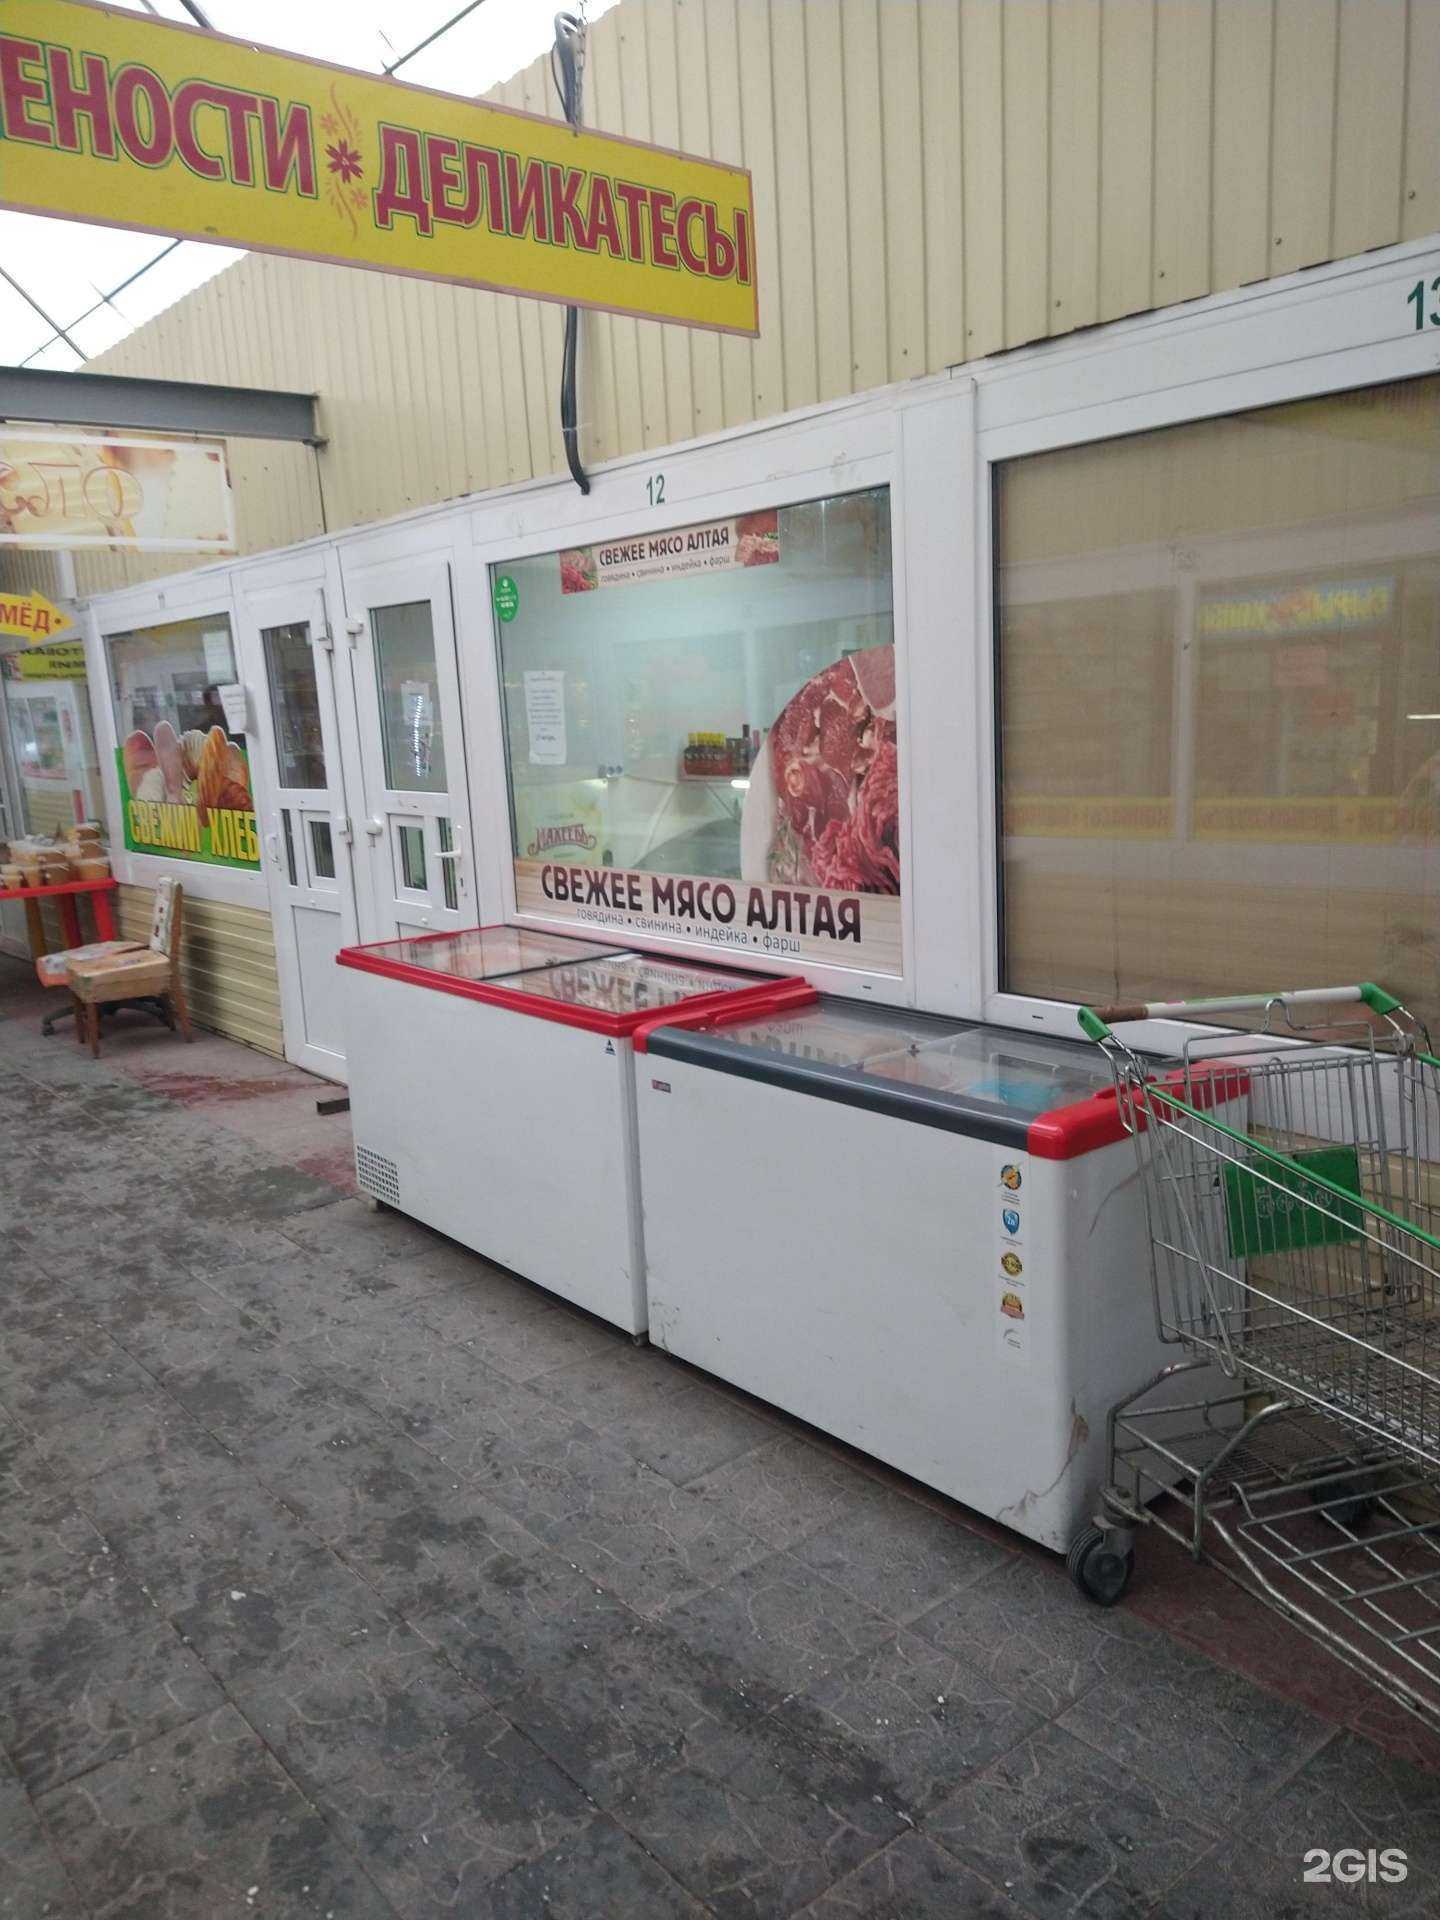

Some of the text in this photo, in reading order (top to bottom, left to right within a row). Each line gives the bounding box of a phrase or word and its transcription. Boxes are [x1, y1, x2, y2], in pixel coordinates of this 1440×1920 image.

[0, 34, 751, 285] ЕНОСТИ ДЕЛИКАТЕСЫ
[646, 474, 666, 506] 12
[599, 526, 730, 566] СВЕЖЕЕ МЯСО АЛТАЯ
[0, 602, 50, 634] МЁД
[206, 807, 260, 862] ХЛЕБ
[541, 865, 862, 944] СВЕЖЕЕ МЯСО АЛТАЯ
[576, 907, 801, 954] говядина свинина индейка фарш
